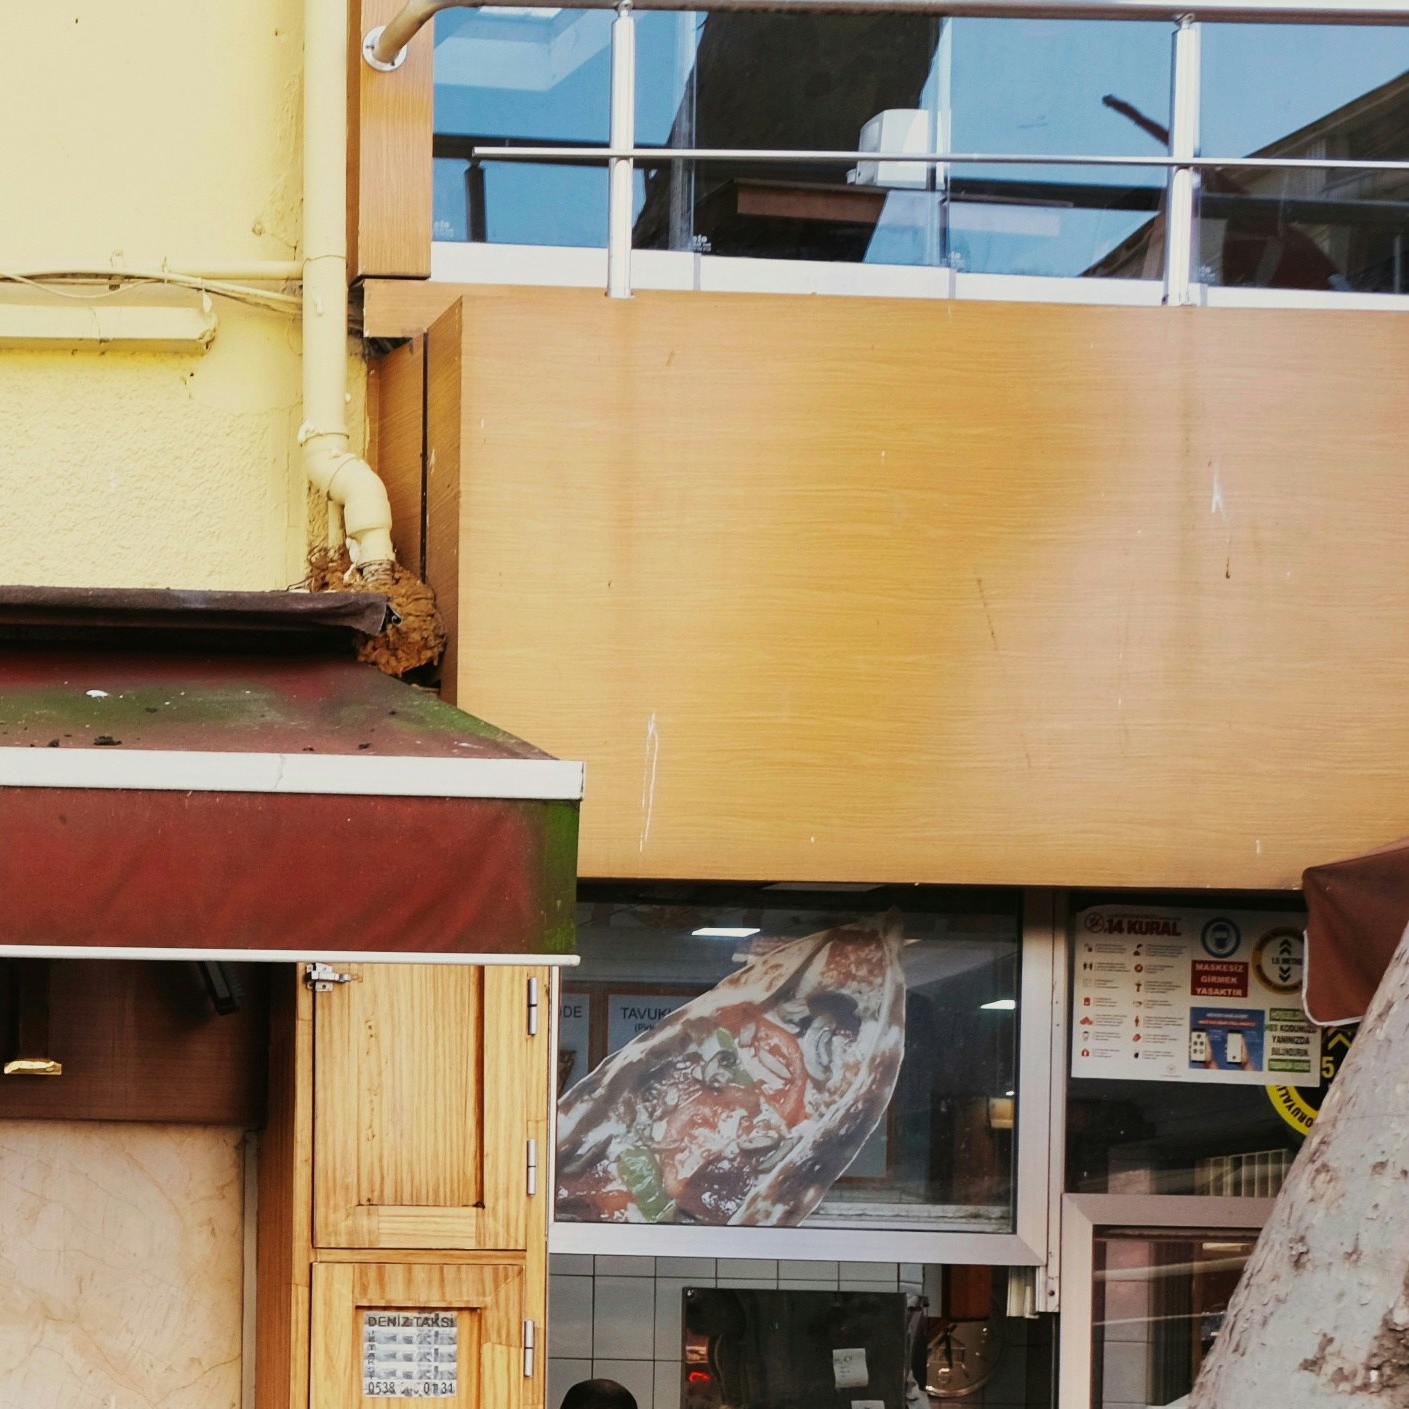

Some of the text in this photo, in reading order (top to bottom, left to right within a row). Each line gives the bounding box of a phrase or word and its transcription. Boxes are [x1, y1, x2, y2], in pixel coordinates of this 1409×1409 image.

[1126, 919, 1182, 937] KURAL
[1195, 961, 1245, 973] MASKESİZ
[1200, 974, 1238, 985] GİRMEK
[1195, 987, 1243, 998] YASAKTIR
